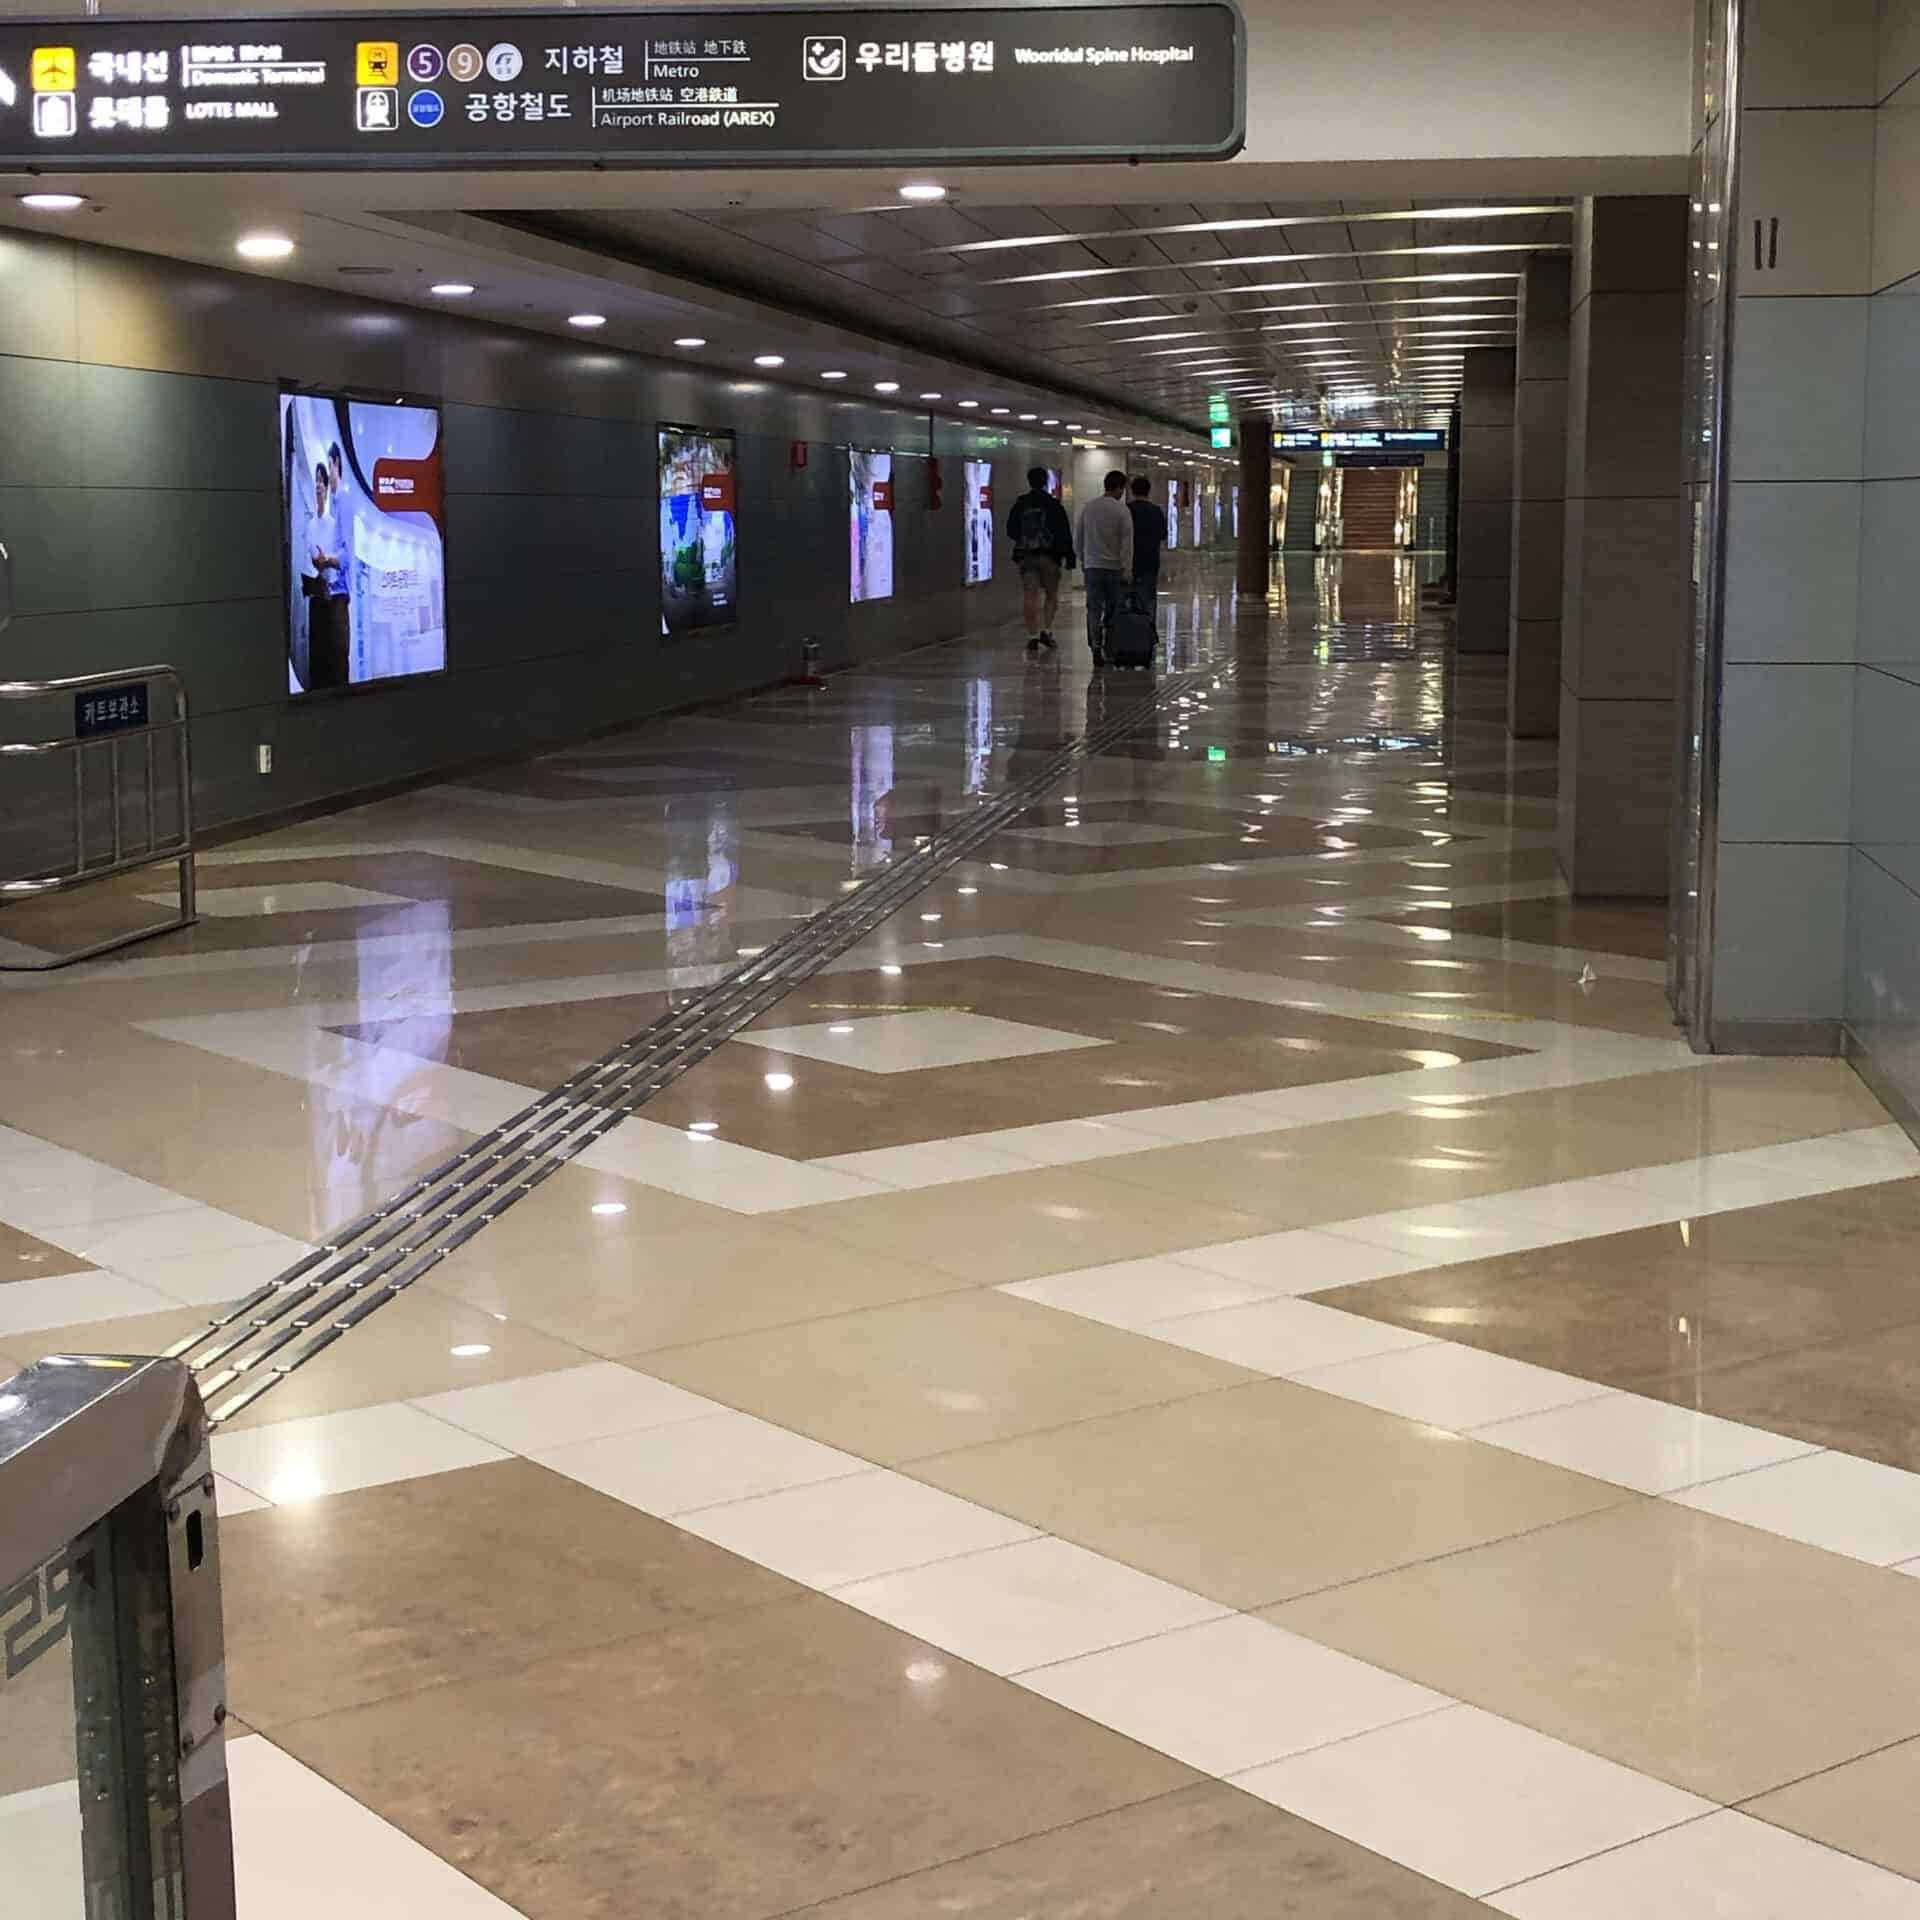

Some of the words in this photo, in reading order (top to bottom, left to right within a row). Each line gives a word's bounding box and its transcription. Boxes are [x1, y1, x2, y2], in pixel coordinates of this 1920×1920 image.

[88, 51, 168, 84] 국내선
[418, 52, 432, 75] 5
[457, 52, 472, 74] 9
[544, 45, 624, 75] 지하철
[856, 41, 994, 72] 우리들병원
[1014, 47, 1083, 64] Wooridul
[1085, 47, 1129, 66] Spine
[1131, 46, 1194, 64] Hospital
[653, 65, 699, 78] Metro
[185, 101, 233, 119] LOTTE
[234, 101, 279, 118] MALL
[464, 92, 572, 122] 공항철도
[601, 112, 653, 128] Airport
[658, 110, 720, 126] Railroad
[723, 110, 775, 127] (AREX)
